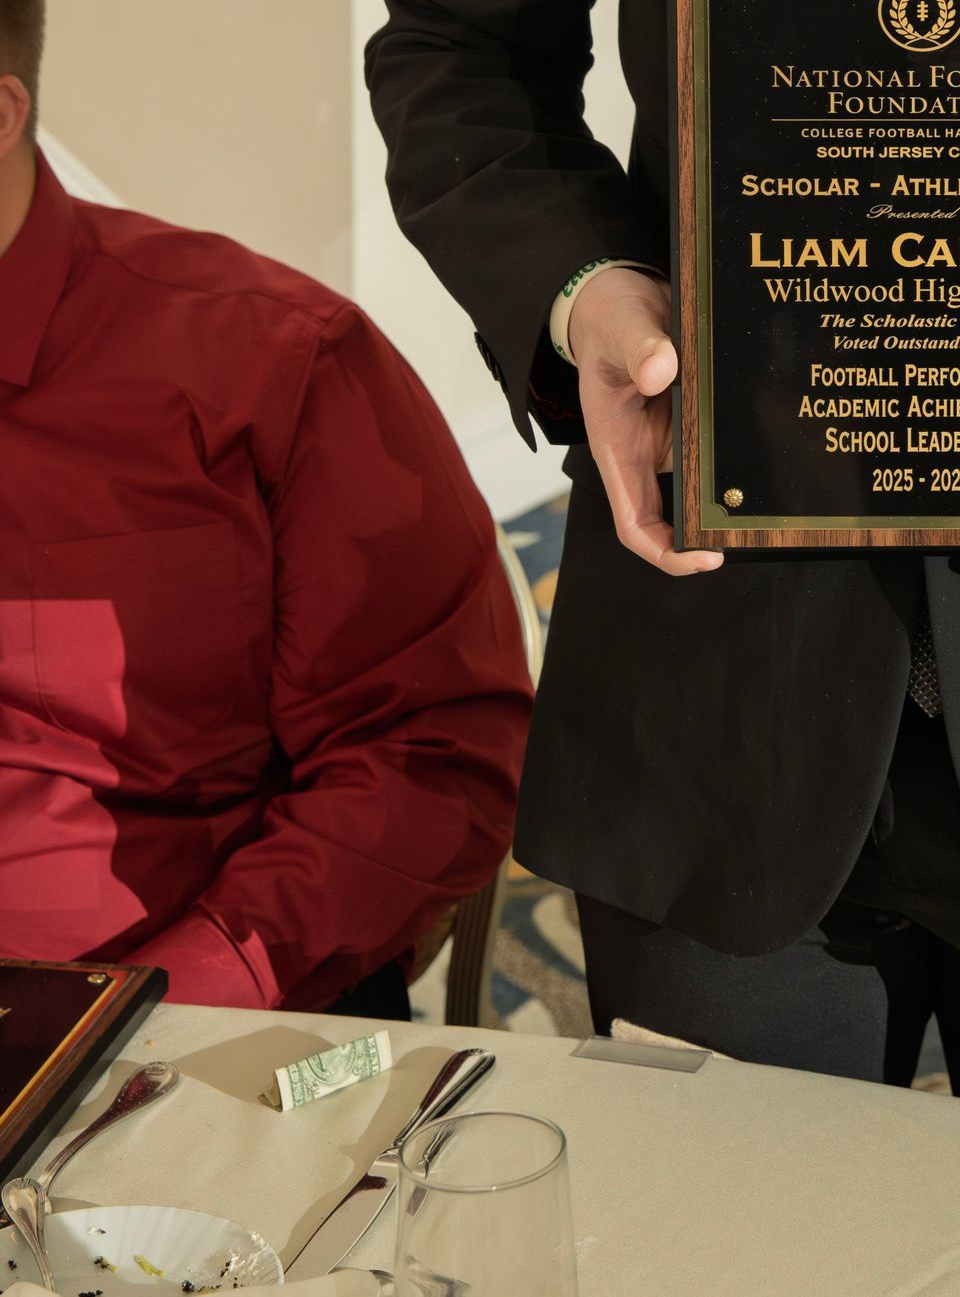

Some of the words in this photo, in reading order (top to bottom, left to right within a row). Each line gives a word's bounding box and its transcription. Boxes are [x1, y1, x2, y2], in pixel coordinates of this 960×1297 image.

[770, 65, 921, 88] NATIONAL
[800, 127, 864, 138] COLLEGE
[868, 128, 941, 138] FOOTBALL
[816, 146, 875, 159] SOUTH
[878, 146, 945, 159] JERSEY
[741, 174, 860, 197] SCHOLAR
[749, 232, 869, 269] LIAM
[762, 277, 905, 303] Wildwood
[819, 313, 856, 328] The
[859, 313, 958, 328] Scholastic
[834, 335, 880, 350] Voted
[810, 363, 899, 387] FOOTBALL
[797, 395, 900, 419] ACADEMIC
[825, 426, 901, 453] SCHOOL
[872, 468, 914, 492] 2025
